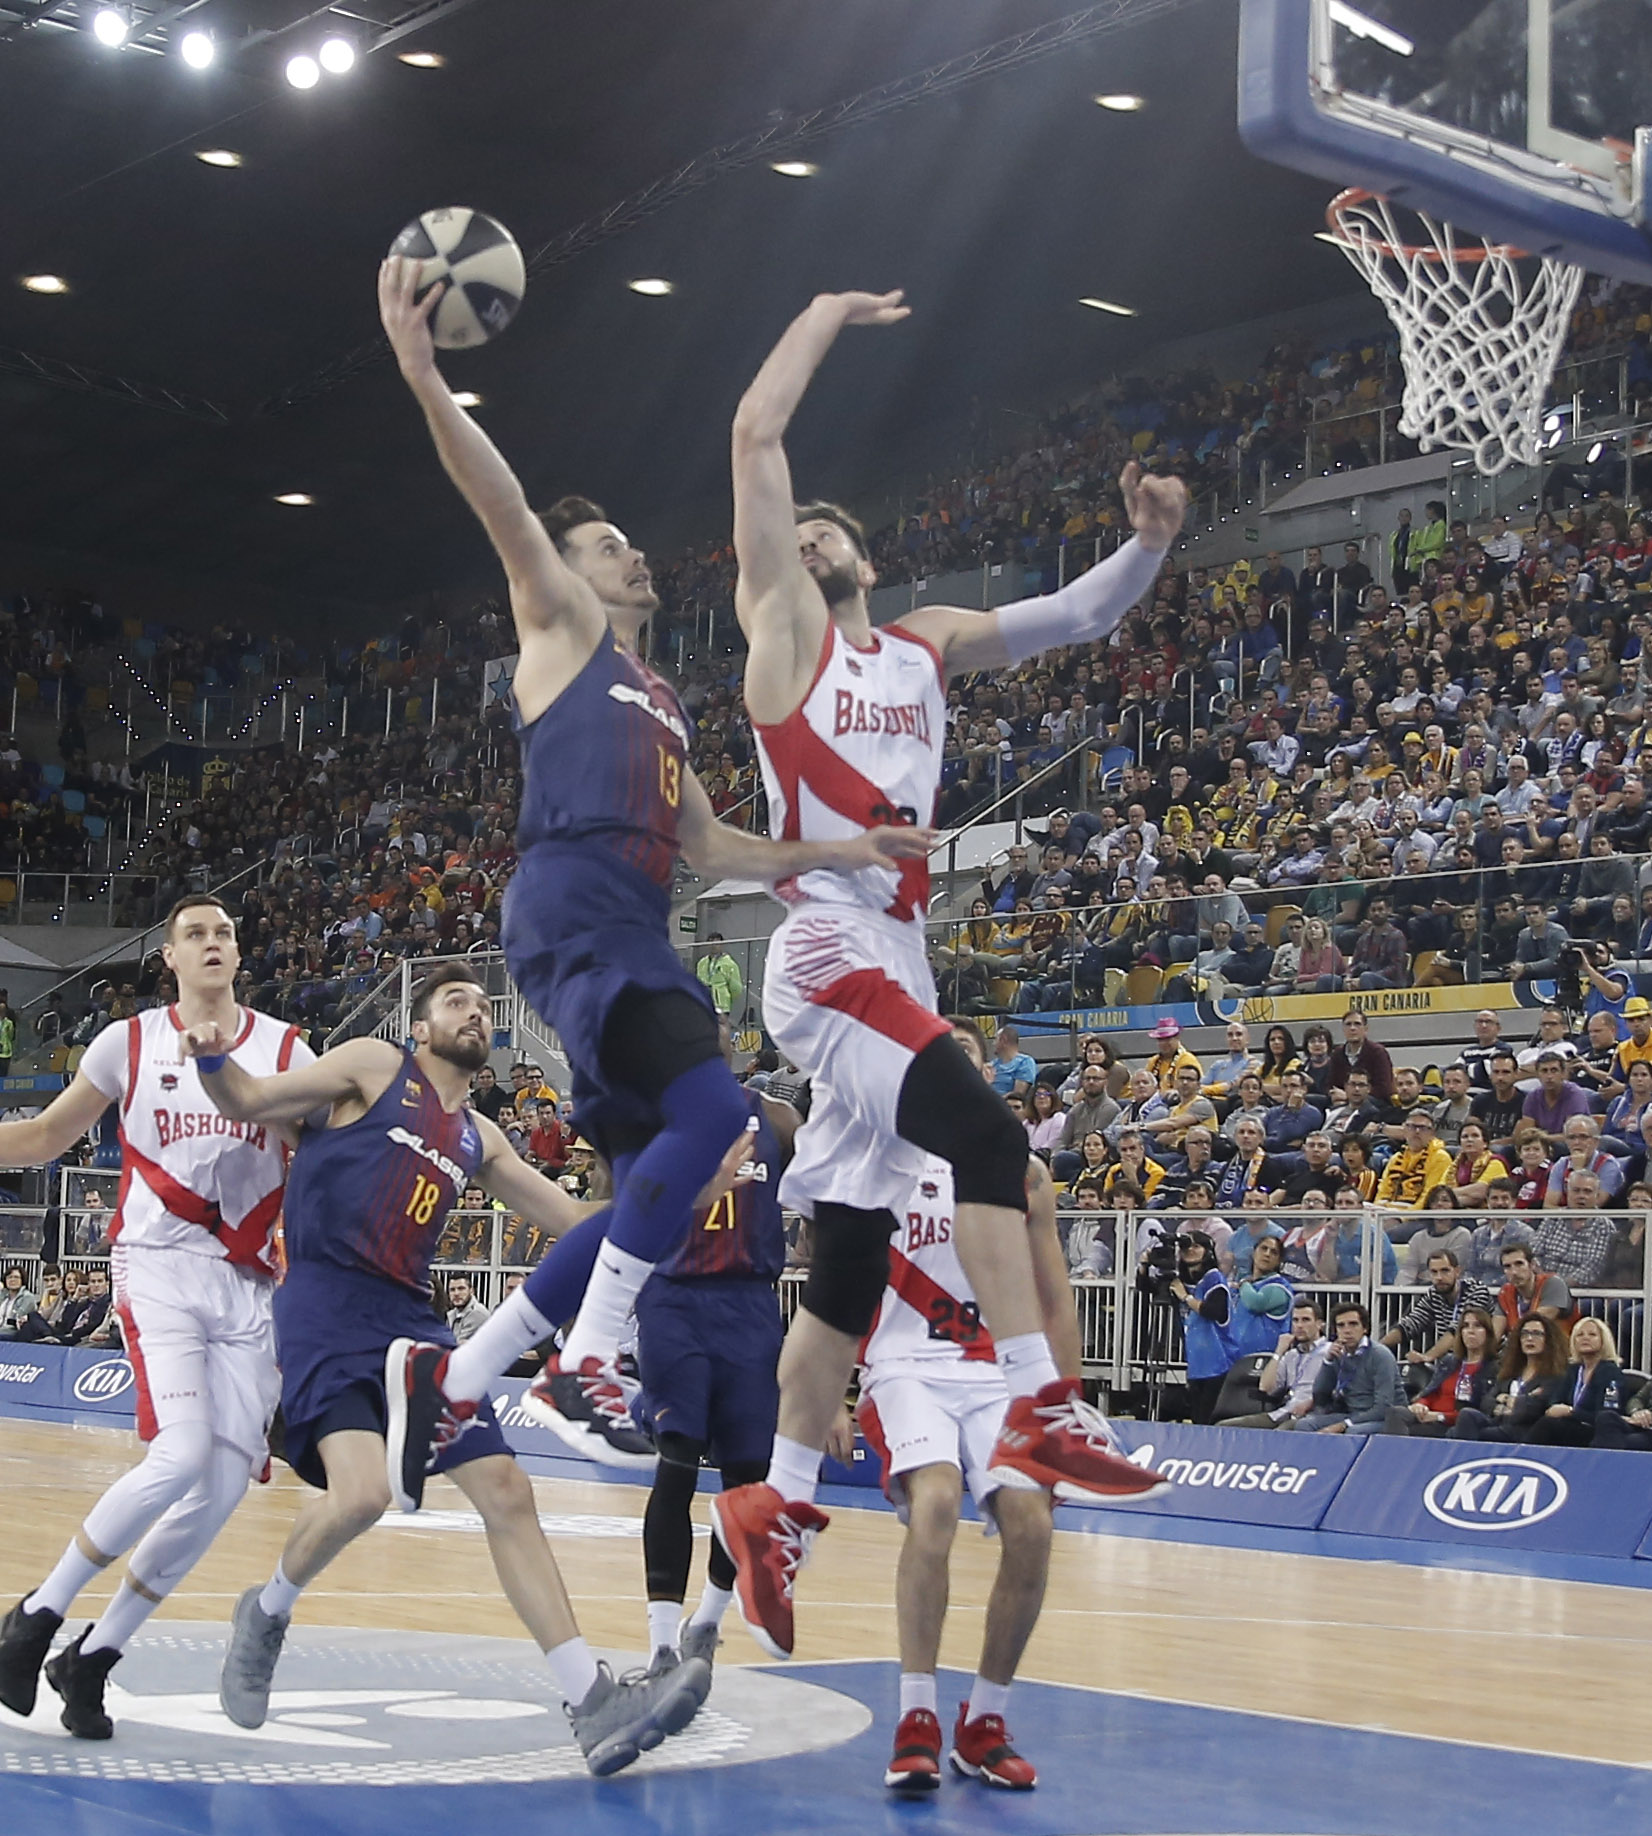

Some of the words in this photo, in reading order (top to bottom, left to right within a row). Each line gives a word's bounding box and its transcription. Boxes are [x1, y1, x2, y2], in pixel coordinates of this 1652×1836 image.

[657, 744, 679, 807] 13
[1349, 994, 1378, 1012] GRAN
[1383, 991, 1431, 1011] CANARIA
[405, 1173, 440, 1225] 18
[703, 1190, 735, 1230] 21
[928, 1298, 981, 1342] 29
[80, 1368, 127, 1393] KIA
[1156, 1458, 1318, 1494] movistar
[1442, 1472, 1539, 1516] KIA
